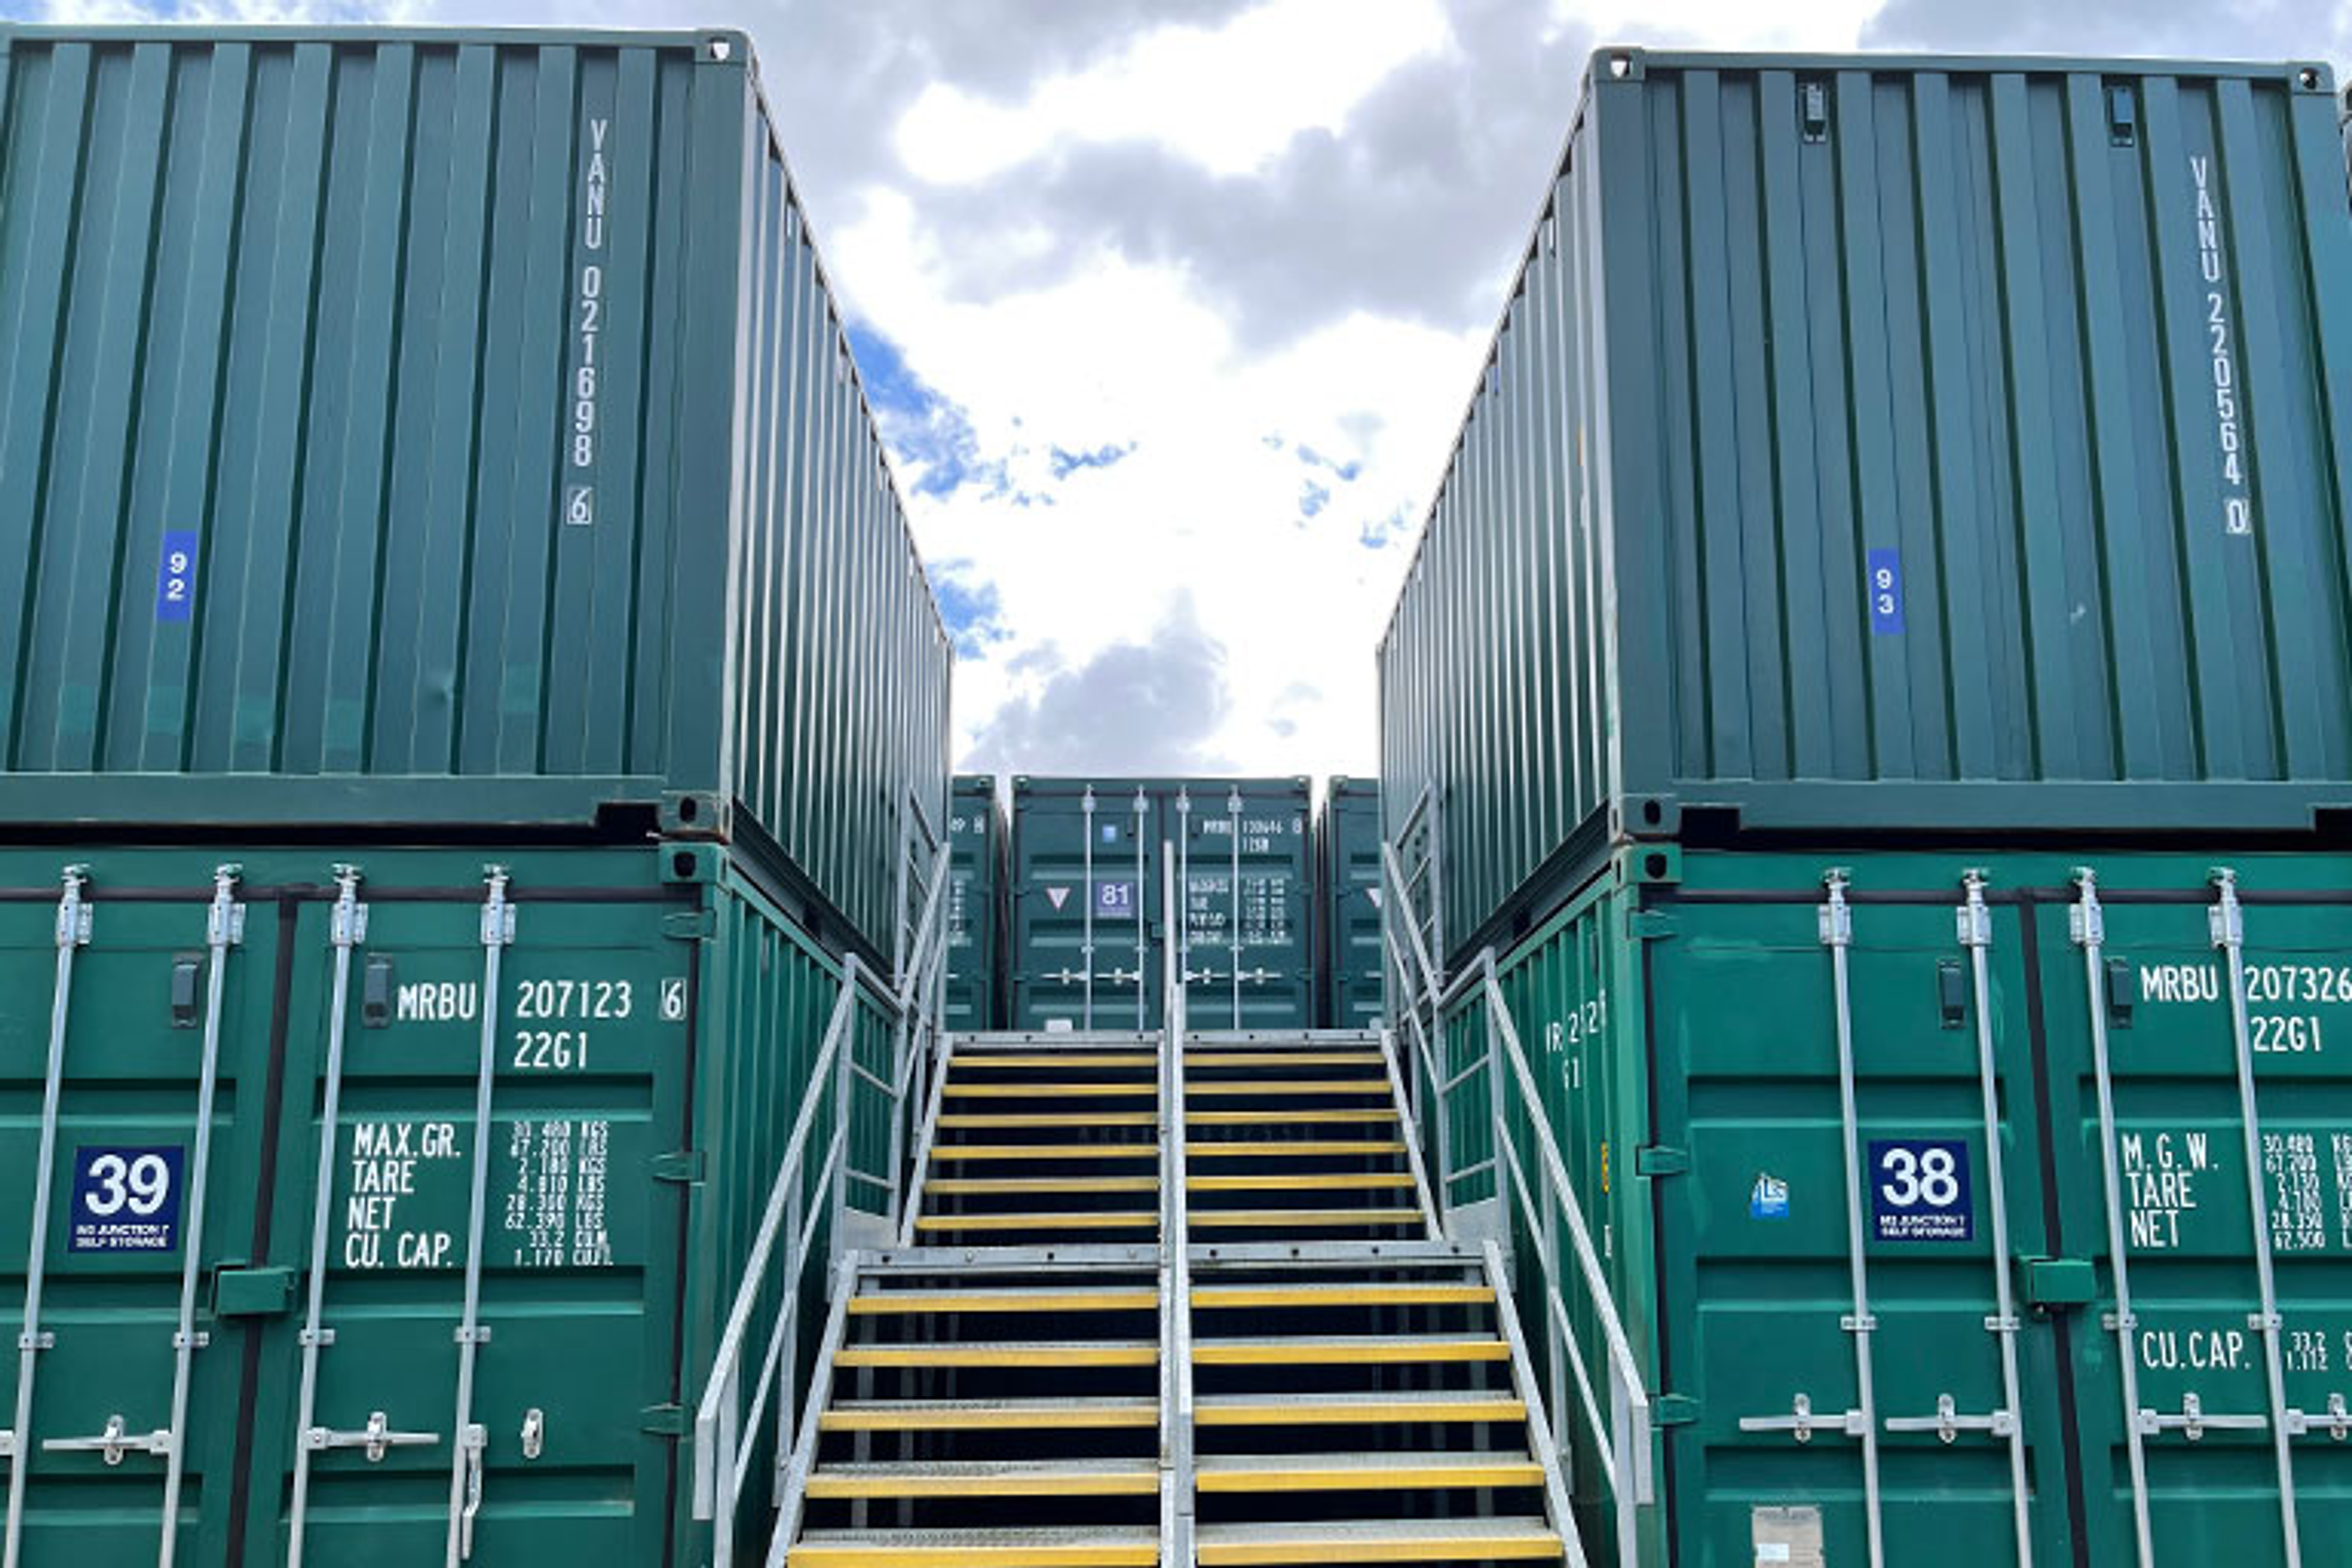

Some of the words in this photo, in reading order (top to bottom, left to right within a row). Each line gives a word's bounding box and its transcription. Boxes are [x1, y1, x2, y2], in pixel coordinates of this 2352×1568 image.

[586, 119, 608, 249] VANU
[2190, 156, 2220, 282] VANU
[2207, 293, 2242, 486] 220564
[574, 265, 601, 468] 021698
[568, 488, 592, 524] 6
[167, 551, 188, 601] 92
[1876, 568, 1894, 614] 93
[1102, 884, 1129, 905] 81
[397, 982, 477, 1020] MRBU
[516, 980, 631, 1018] 207123
[662, 979, 687, 1020] 6
[2140, 965, 2219, 1002] MRBU
[2244, 965, 2352, 1002] 207326
[513, 1031, 588, 1069] 22G1
[2250, 1016, 2322, 1052] 22G1
[353, 1123, 461, 1158] MAX.GR.
[2122, 1133, 2219, 1170] M.G.W.
[85, 1154, 170, 1215] 39
[352, 1159, 418, 1193] TARE
[1882, 1148, 1959, 1207] 38
[2125, 1170, 2197, 1207] TARE
[347, 1196, 396, 1230] NET
[2130, 1208, 2179, 1248] NET
[345, 1232, 384, 1268] CU.
[398, 1231, 453, 1267] CAP.
[2143, 1331, 2252, 1370] CU.CAP.
